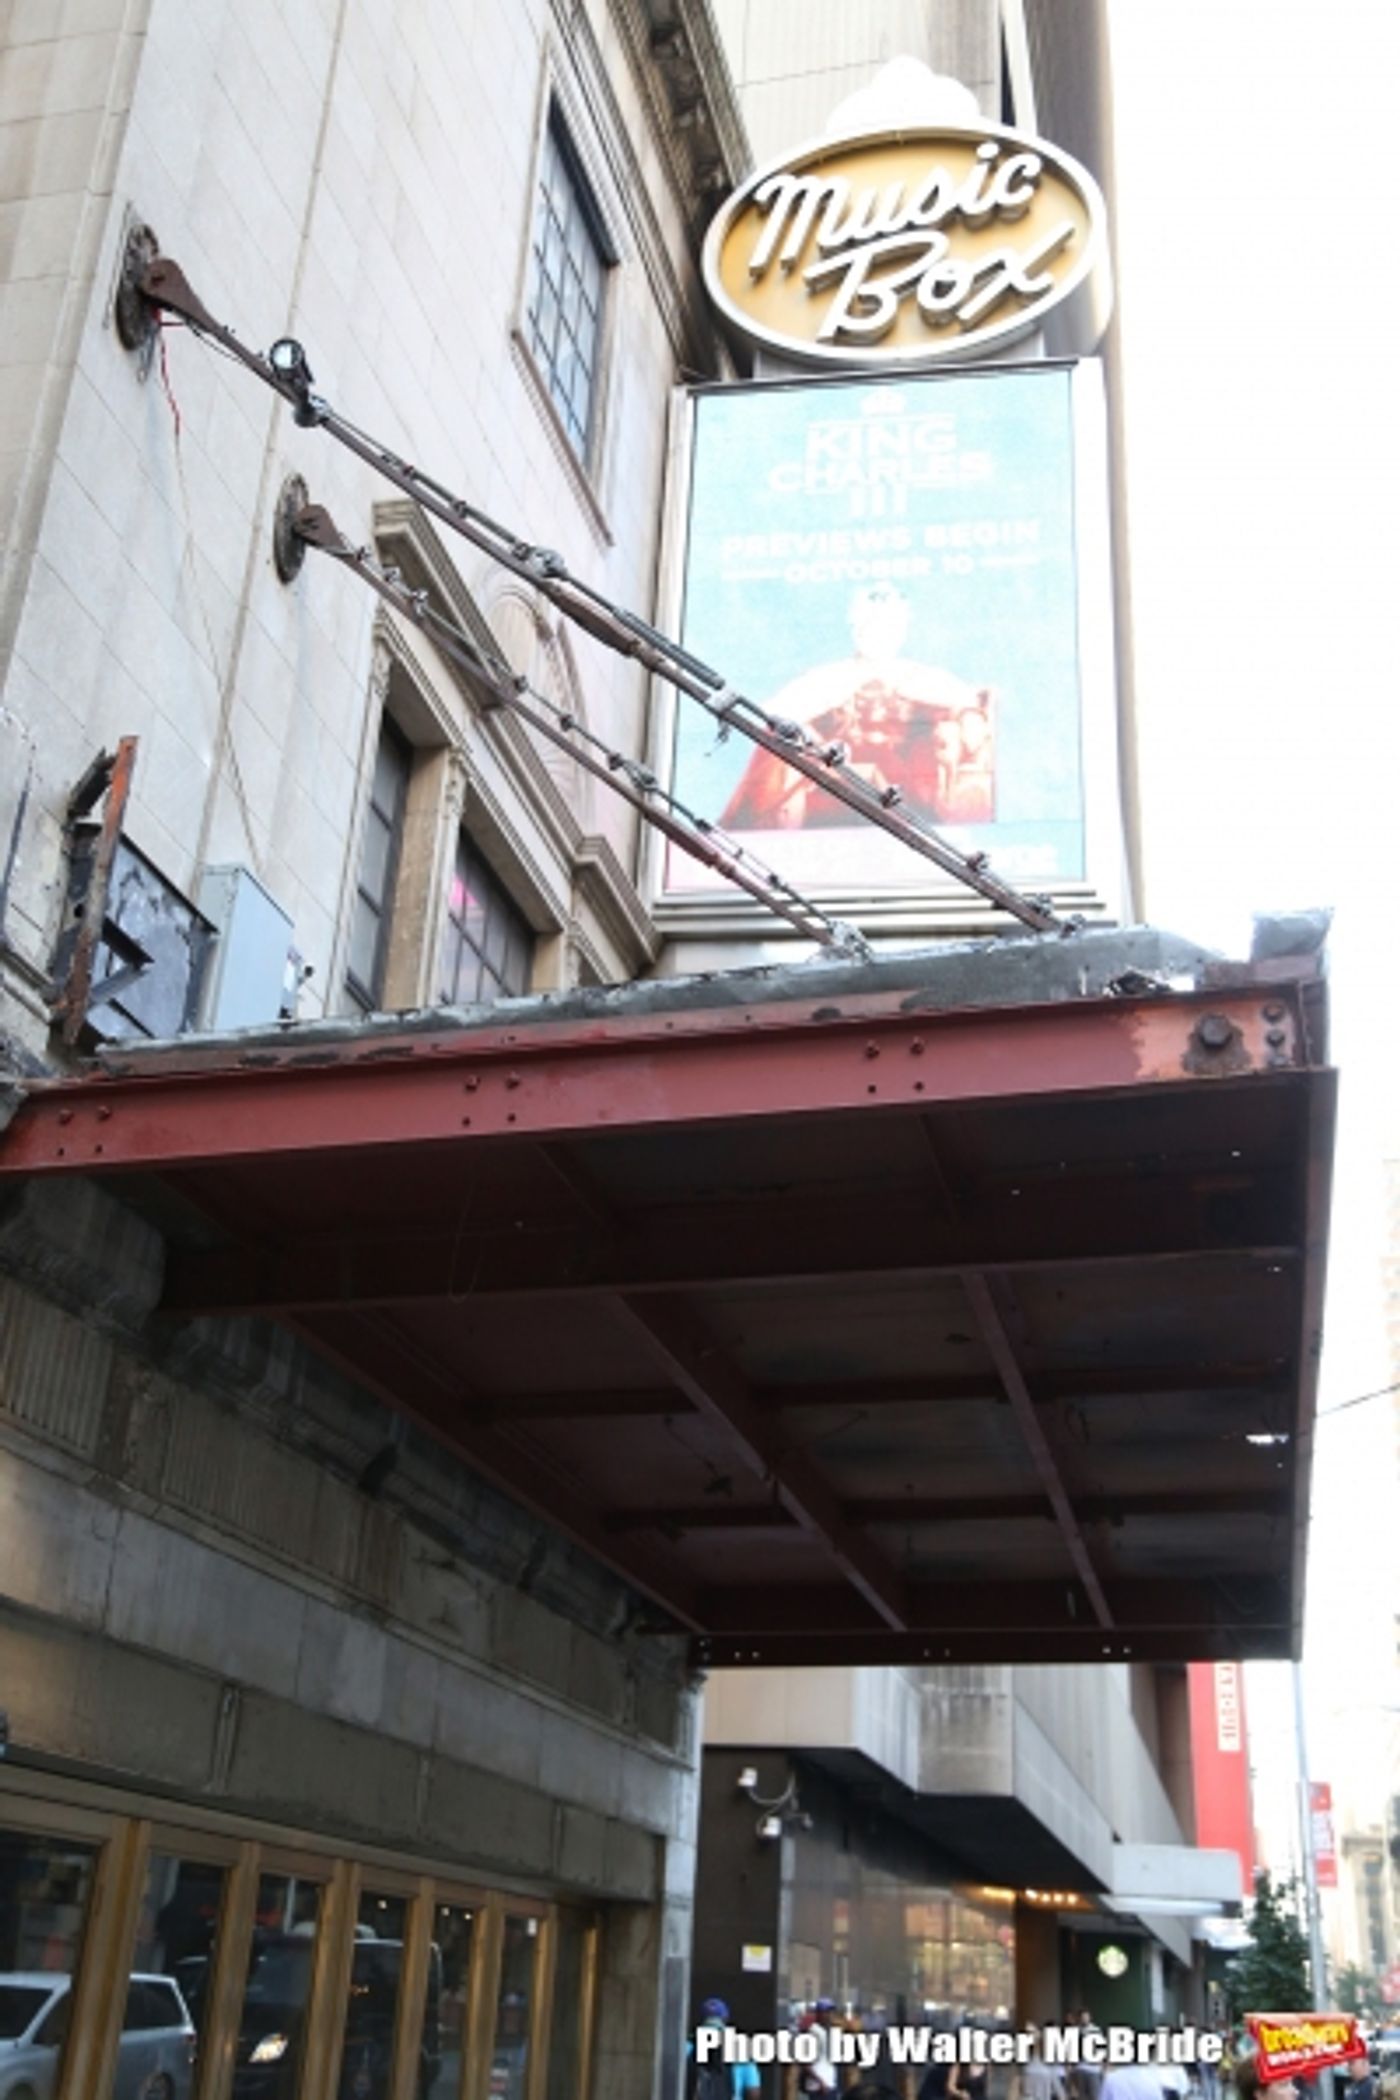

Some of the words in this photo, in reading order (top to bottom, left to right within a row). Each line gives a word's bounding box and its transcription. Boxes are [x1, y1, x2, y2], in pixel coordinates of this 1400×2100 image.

[749, 141, 1042, 272] Music
[803, 223, 1076, 344] Box
[805, 413, 957, 459] KING
[769, 451, 992, 495] CHARLES
[848, 484, 908, 518] III
[722, 526, 913, 561] PREVIEWS
[923, 519, 1041, 549] BEGIN
[783, 556, 932, 584] OCTOBER
[942, 553, 975, 576] 10
